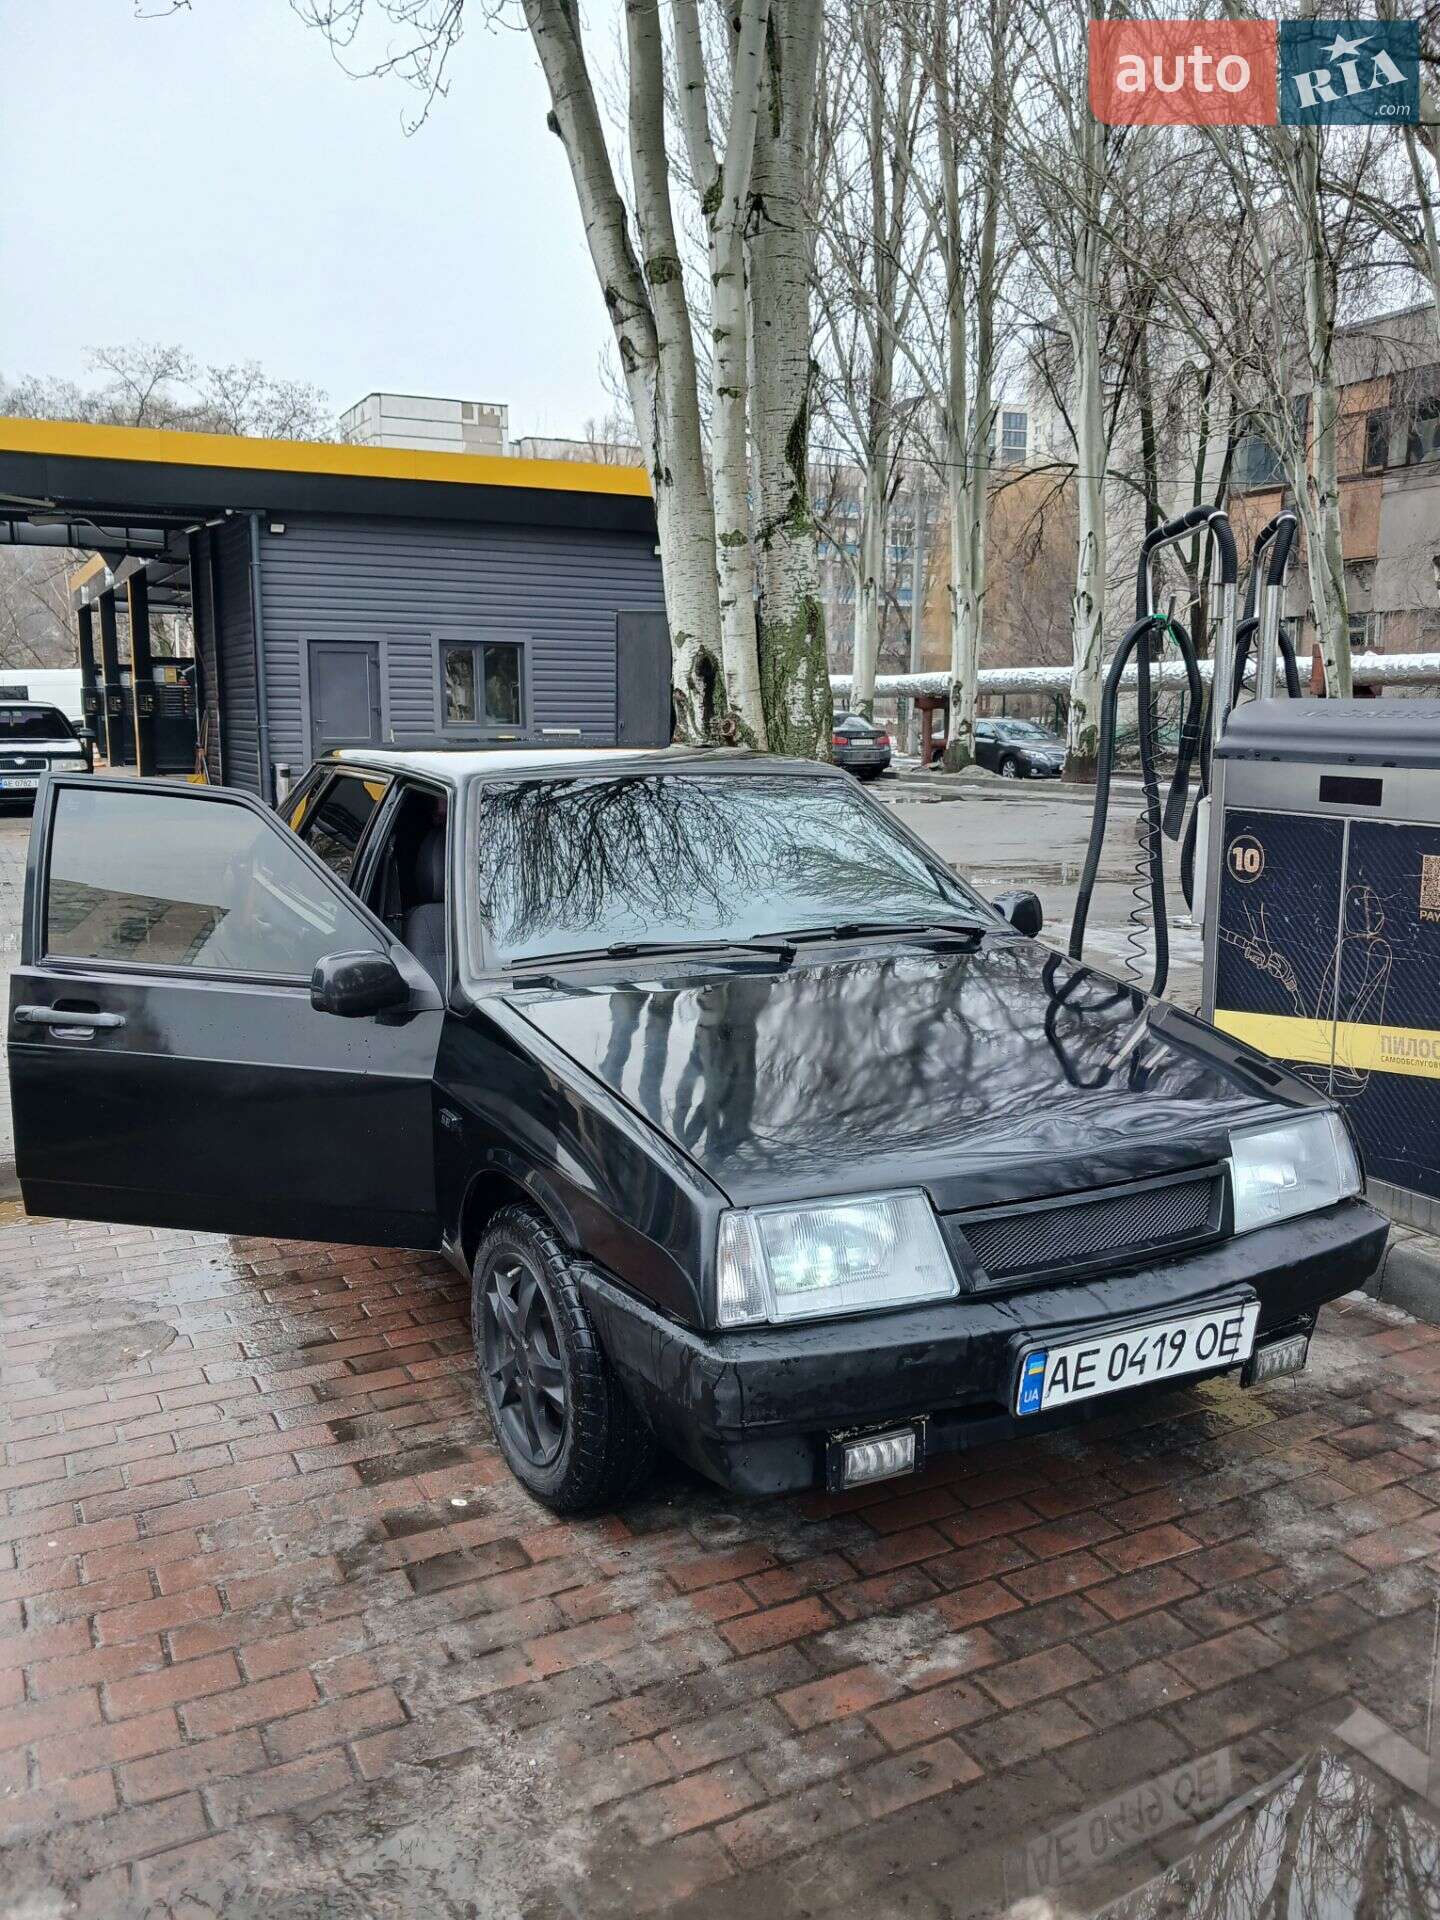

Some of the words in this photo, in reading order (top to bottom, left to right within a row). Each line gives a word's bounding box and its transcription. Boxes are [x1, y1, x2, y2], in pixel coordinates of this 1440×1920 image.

[1233, 847, 1260, 873] 10
[1380, 1056, 1440, 1068] САМООБСЛУГОВ
[1047, 1348, 1101, 1394] AE
[1107, 1328, 1187, 1382] 0419
[1195, 1317, 1245, 1361] OE
[1023, 1390, 1039, 1403] UA
